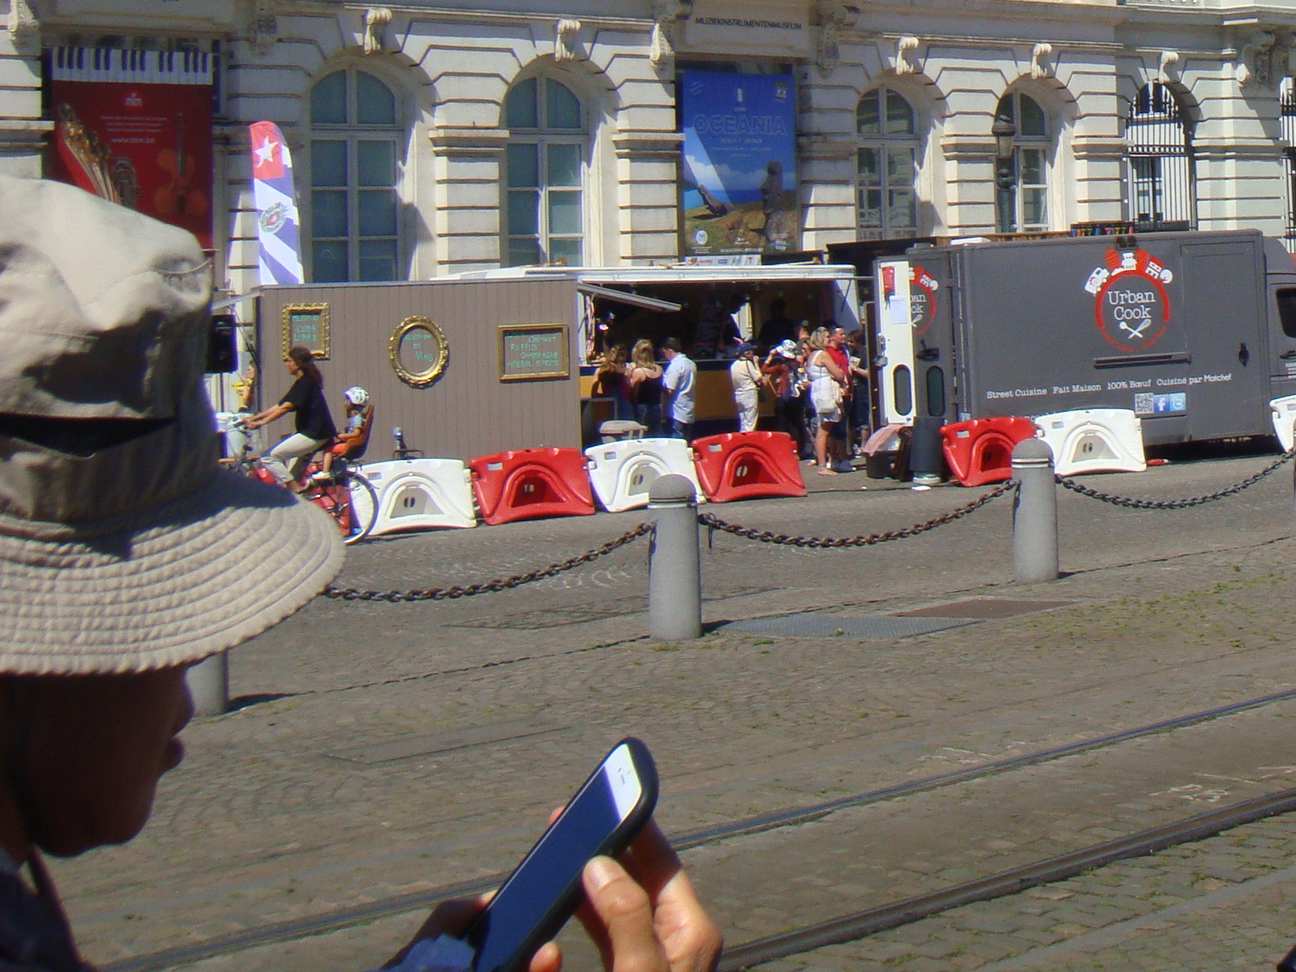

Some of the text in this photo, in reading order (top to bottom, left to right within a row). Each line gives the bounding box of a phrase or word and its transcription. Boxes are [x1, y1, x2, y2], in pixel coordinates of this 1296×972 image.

[693, 114, 788, 135] OCEANIA
[1107, 290, 1157, 305] Urban
[1113, 305, 1153, 321] Cook
[986, 389, 1014, 399] Street
[1015, 387, 1047, 397] Cuisine
[1052, 385, 1070, 394] Fait
[1071, 383, 1102, 393] Maison
[1107, 381, 1128, 390] 100%
[1188, 375, 1202, 385] par
